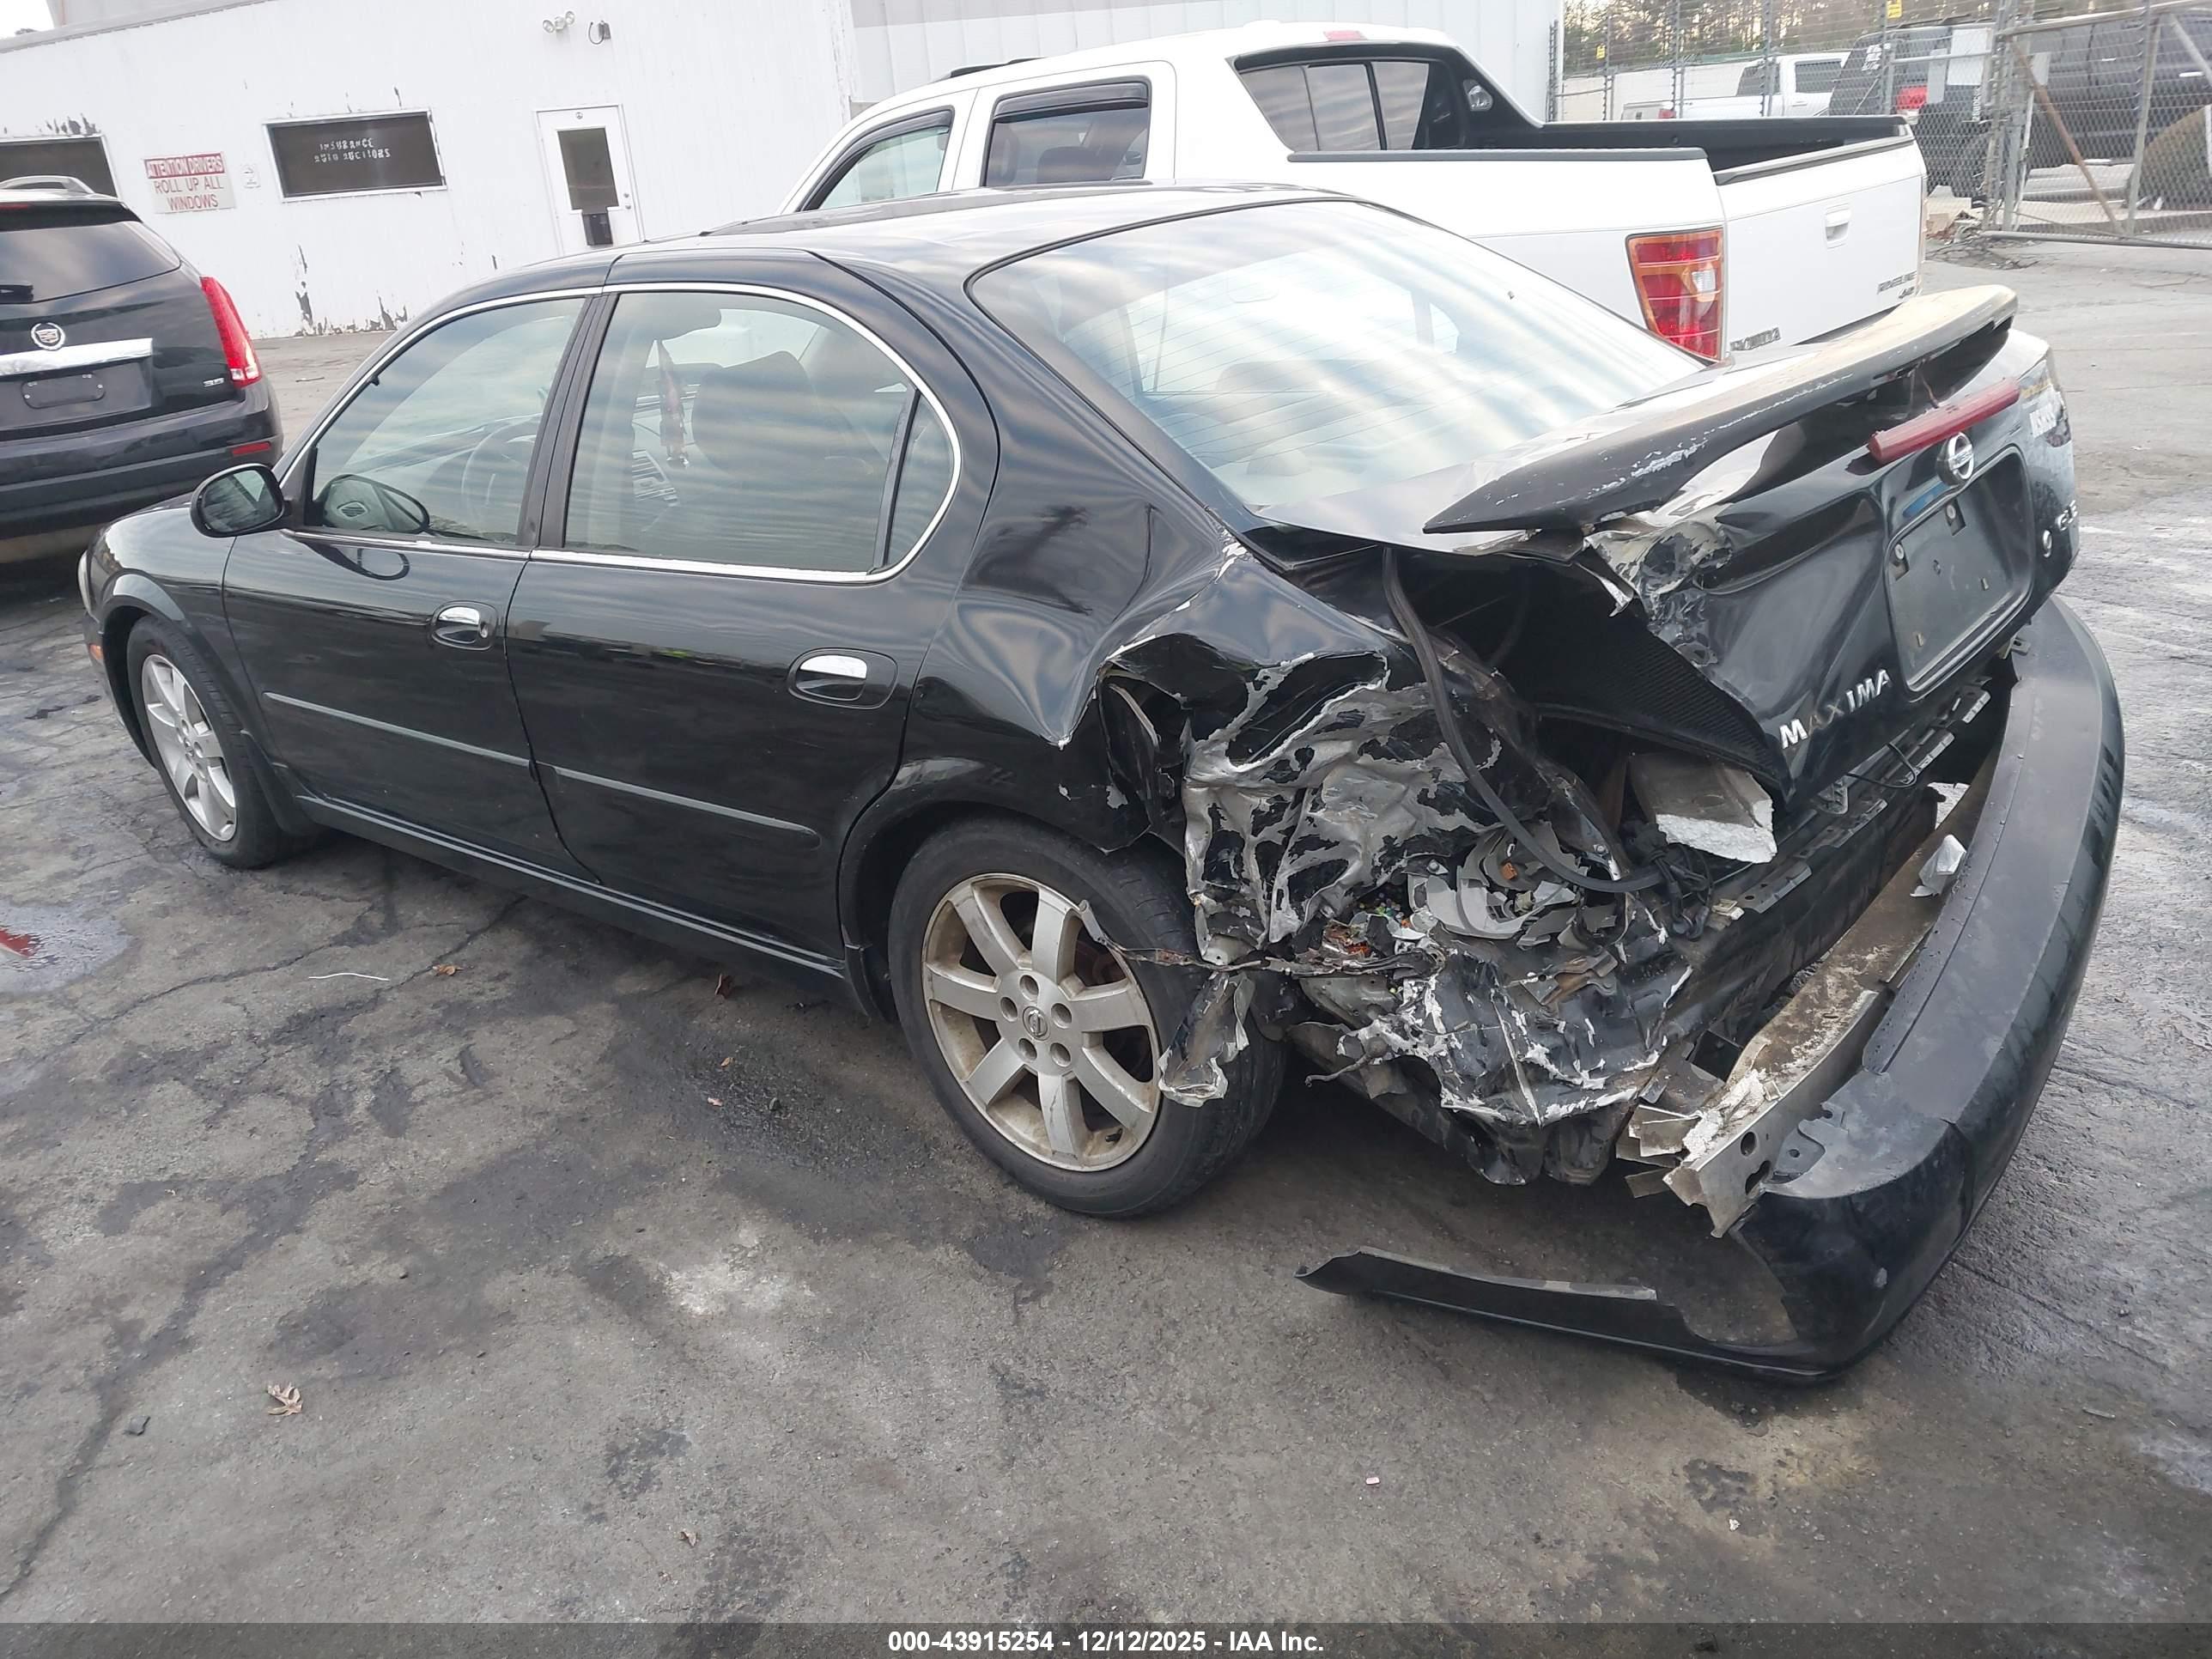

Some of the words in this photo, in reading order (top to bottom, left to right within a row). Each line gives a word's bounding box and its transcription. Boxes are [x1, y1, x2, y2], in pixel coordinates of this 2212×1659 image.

[147, 157, 188, 178] ATTENTION
[188, 155, 224, 174] DRIVERS
[154, 178, 183, 193] ROLL
[185, 177, 199, 191] UP
[204, 176, 224, 191] ALL
[167, 193, 219, 211] WINDOWS
[1779, 668, 1891, 750] MAXIMA
